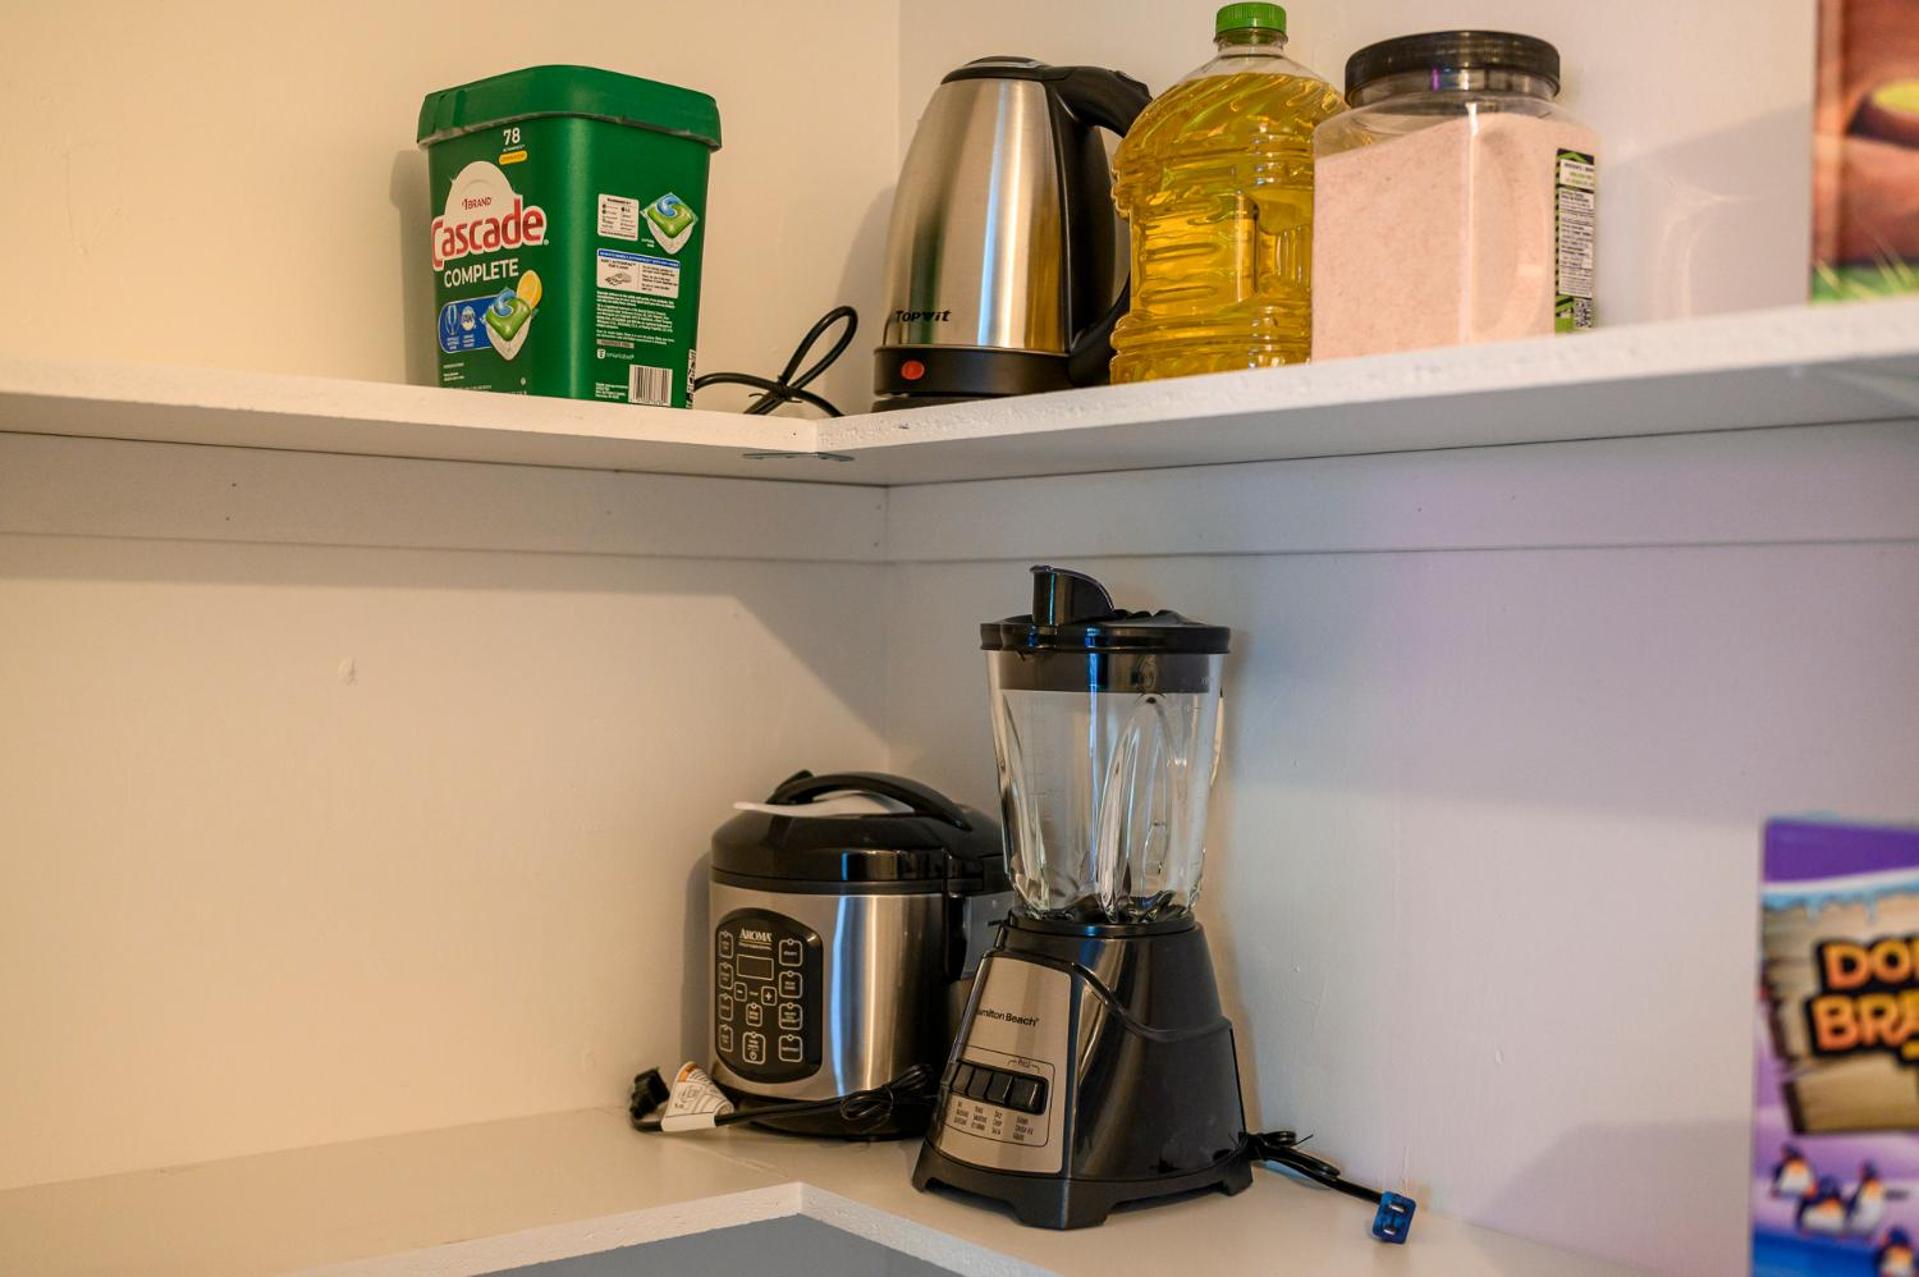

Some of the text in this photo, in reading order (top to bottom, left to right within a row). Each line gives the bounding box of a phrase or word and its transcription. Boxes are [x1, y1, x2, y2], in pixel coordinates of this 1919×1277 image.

[503, 127, 521, 146] 78
[432, 198, 544, 268] Cascade
[444, 258, 519, 288] COMPLETE
[1822, 938, 1919, 989] DO
[1006, 1013, 1037, 1027] Beach
